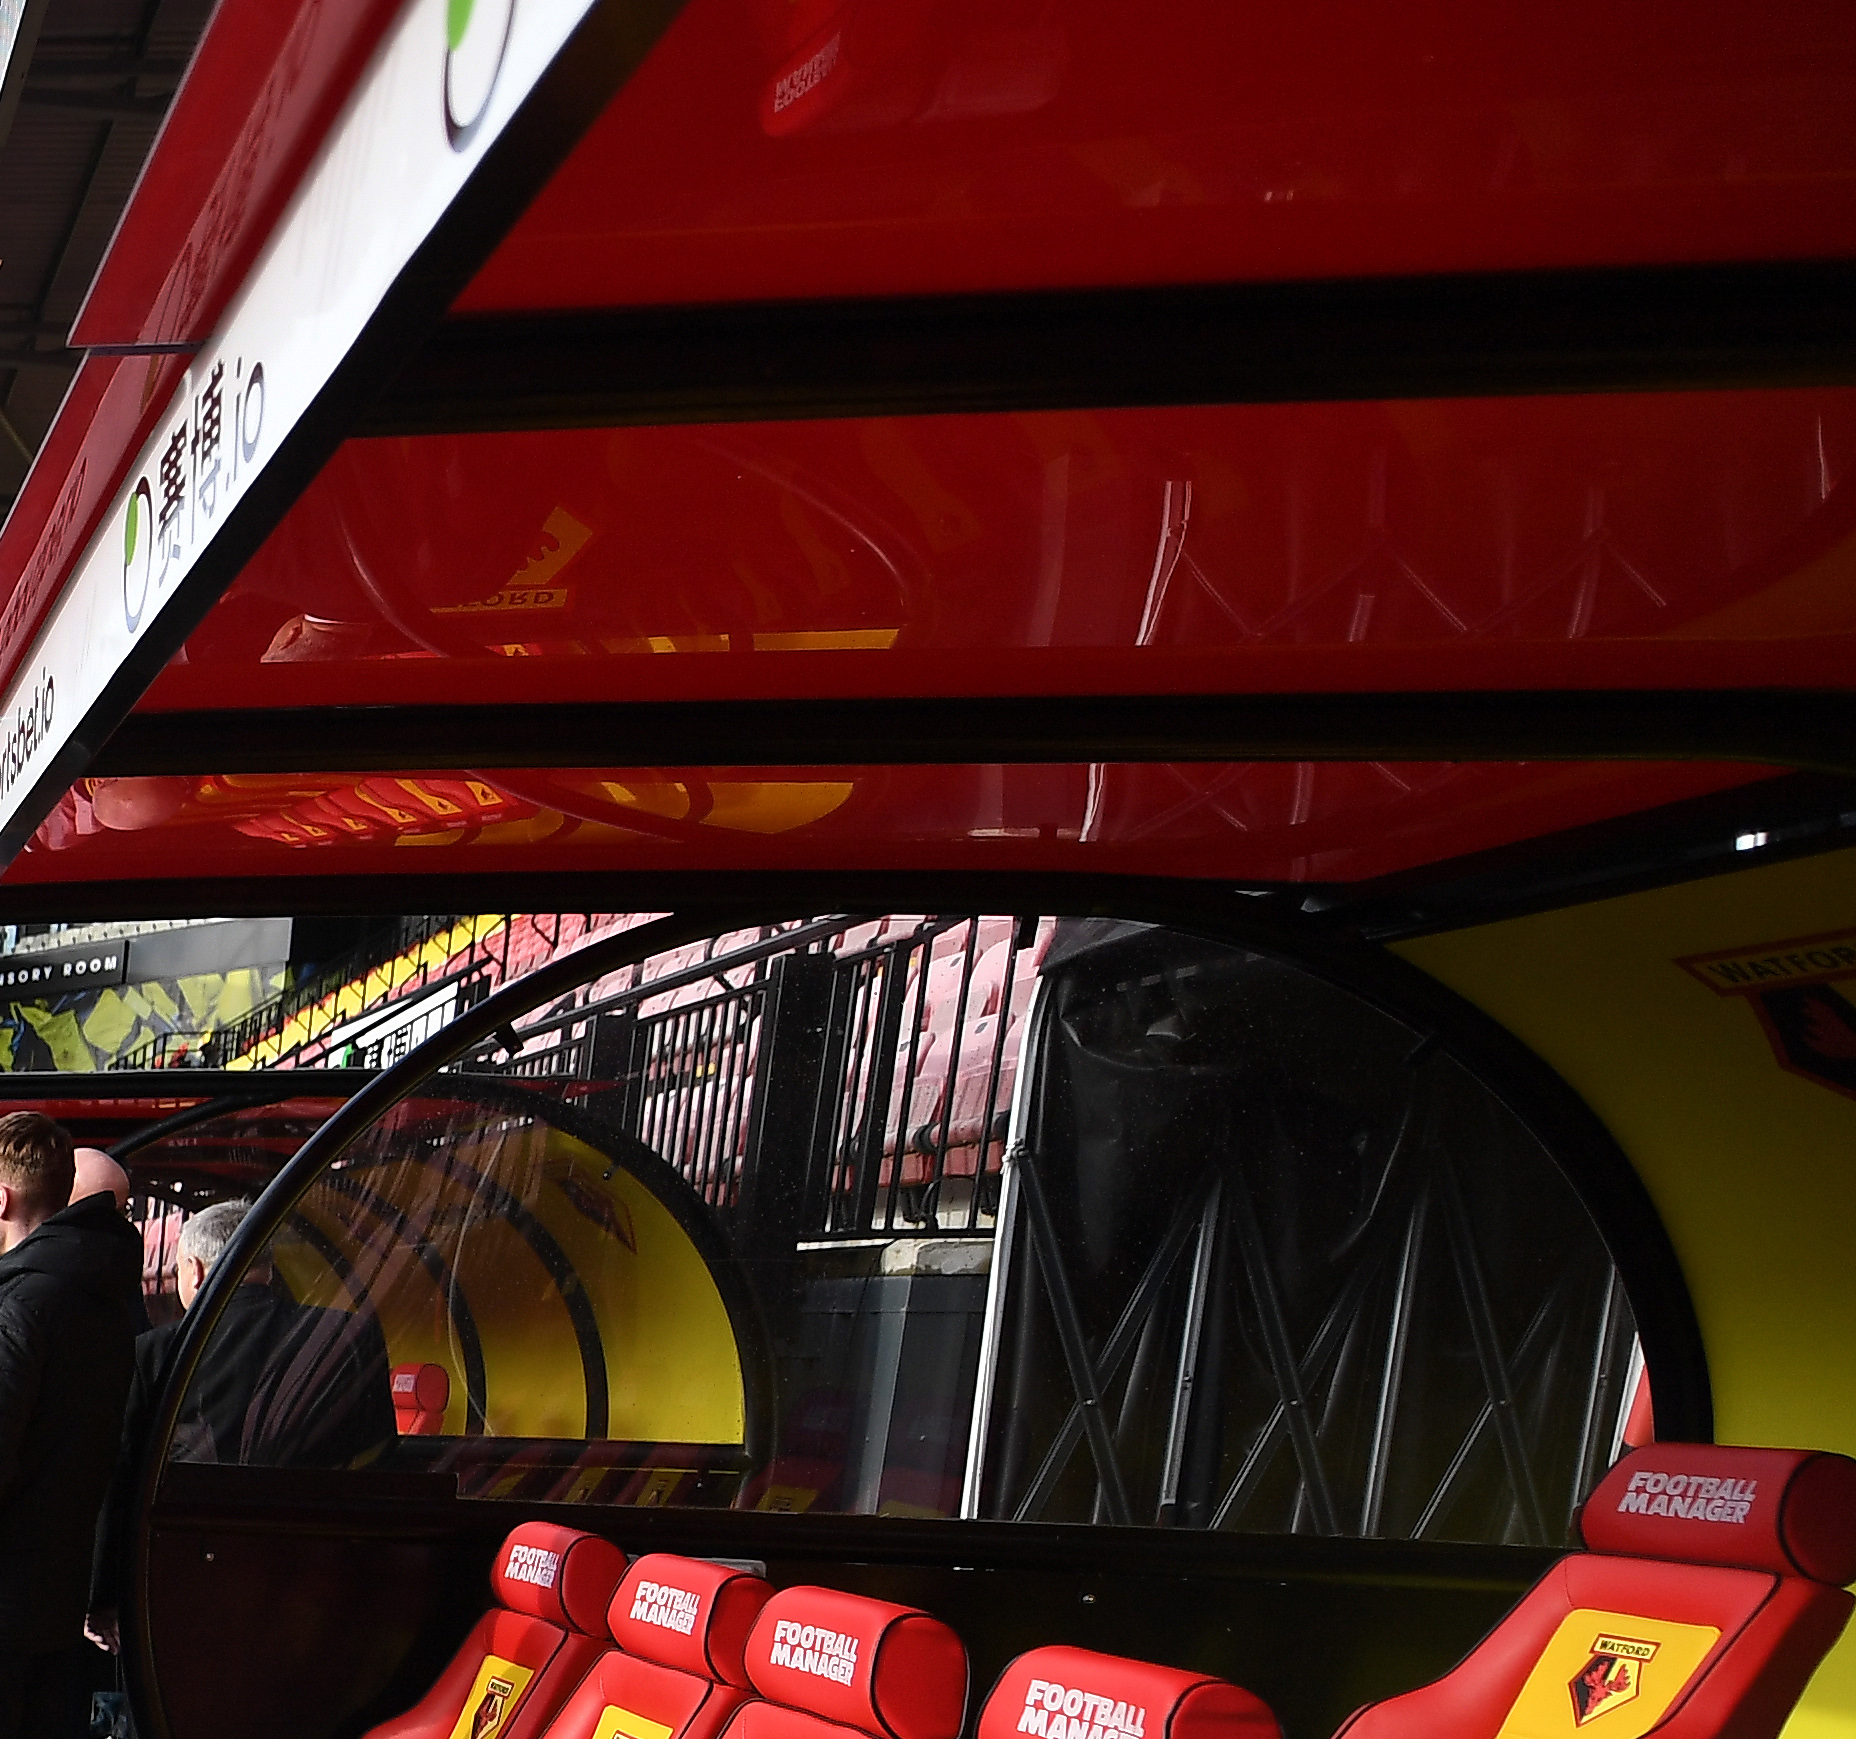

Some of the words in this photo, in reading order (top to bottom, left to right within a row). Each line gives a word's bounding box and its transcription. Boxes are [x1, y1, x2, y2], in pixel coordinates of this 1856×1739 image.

[63, 955, 118, 977] ROOM
[1627, 1472, 1758, 1501] FOOTBALL
[1617, 1492, 1751, 1524] MANAGER
[509, 1545, 558, 1572] FOOTBALL
[504, 1564, 555, 1588] MANAGER
[635, 1581, 702, 1617] FOOTBALL
[629, 1603, 696, 1636] MANAGER
[775, 1620, 859, 1664] FOOTBALL
[1600, 1640, 1650, 1656] WATFORD
[769, 1643, 854, 1687] MANAGER
[1025, 1679, 1145, 1739] FOOTBALL
